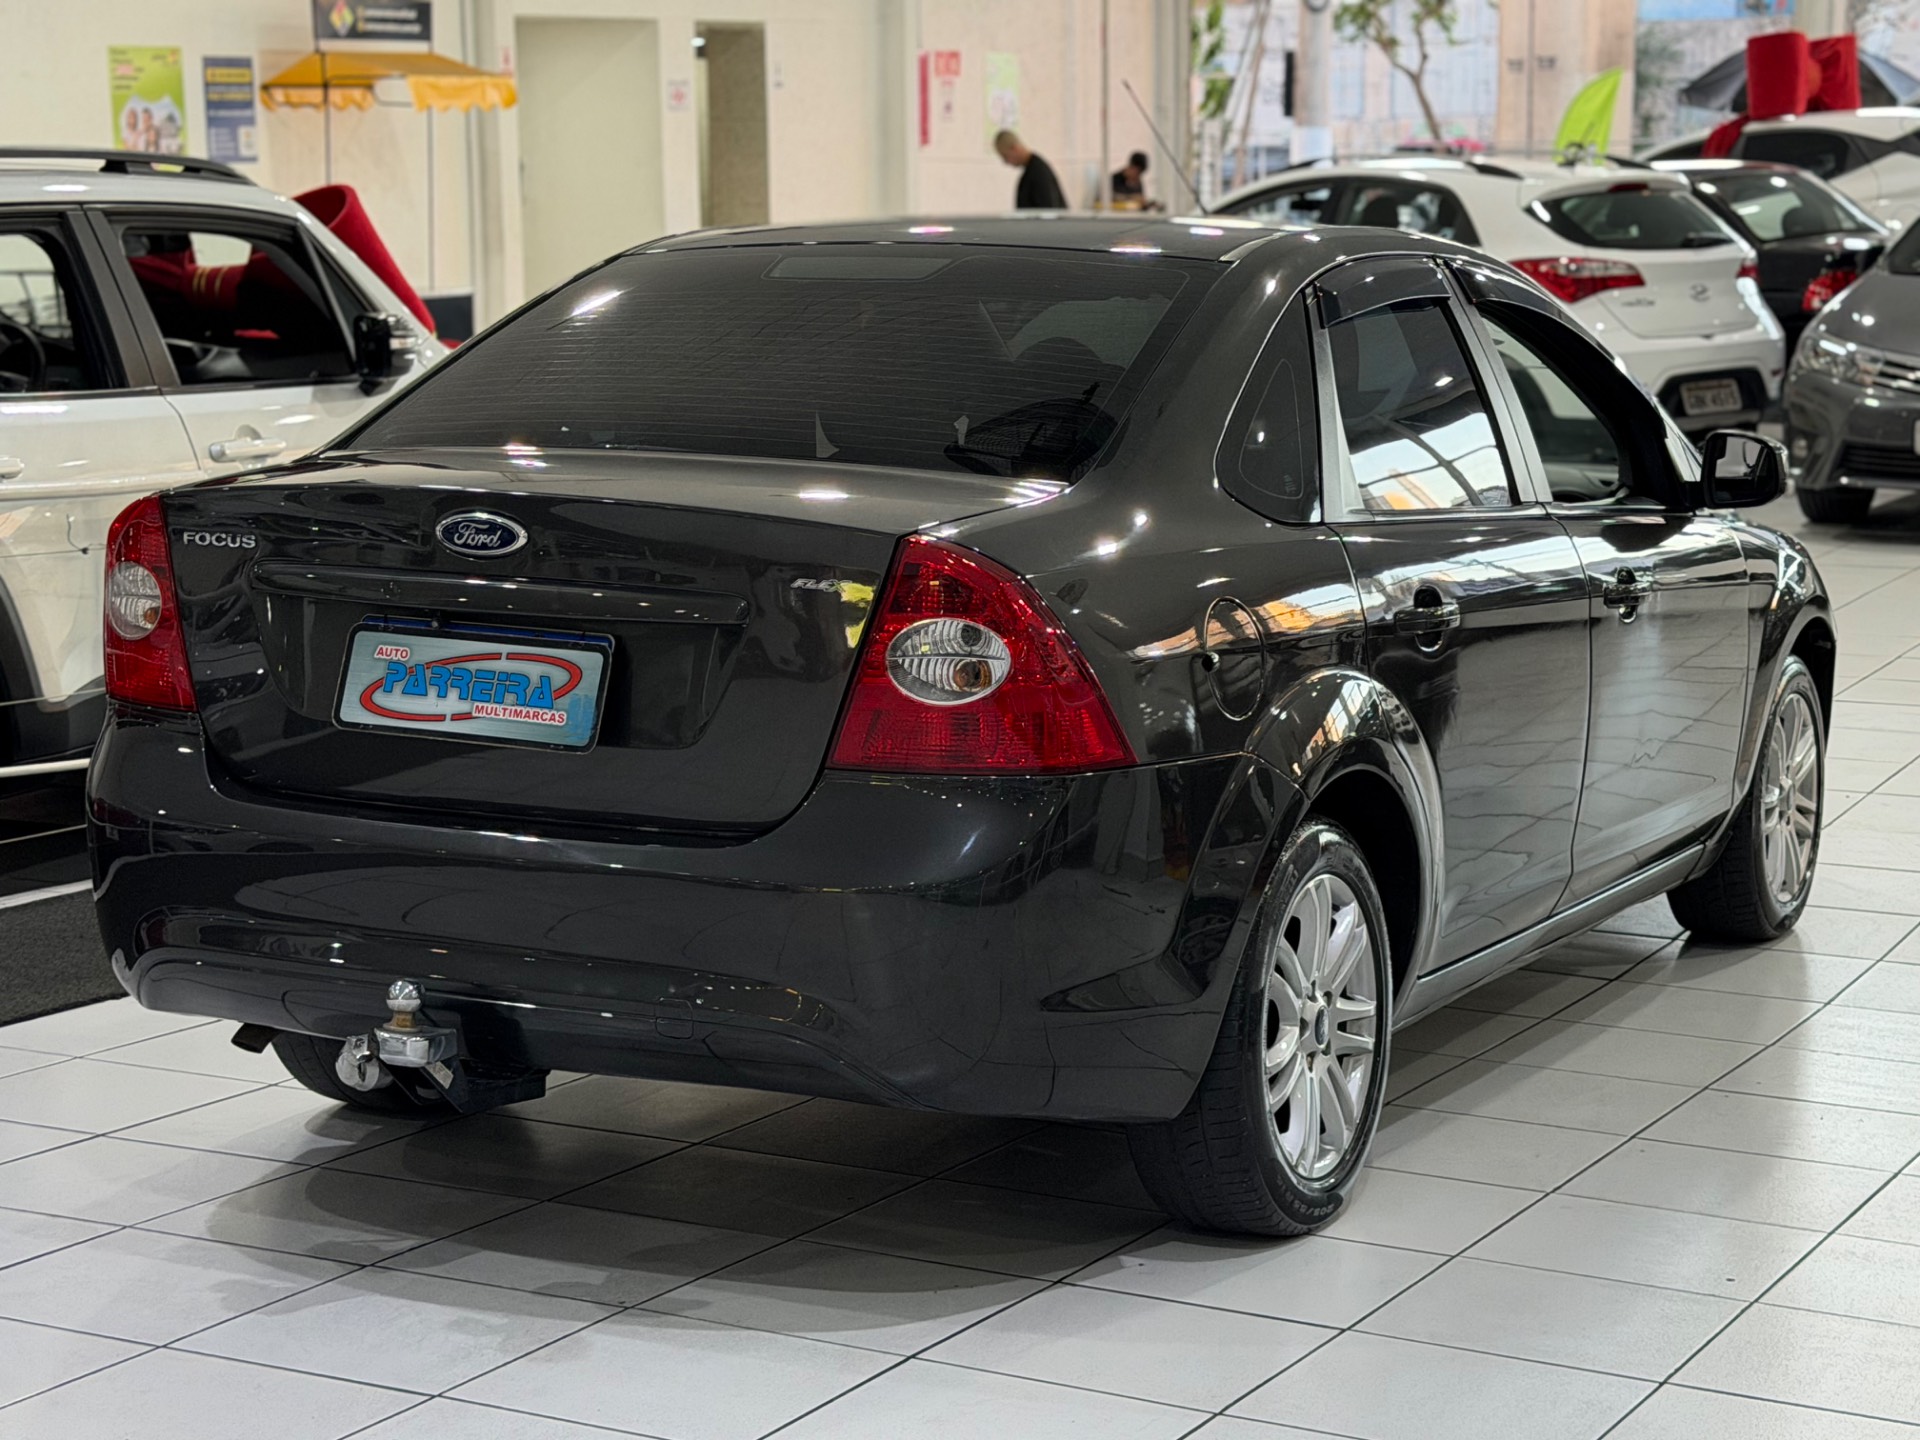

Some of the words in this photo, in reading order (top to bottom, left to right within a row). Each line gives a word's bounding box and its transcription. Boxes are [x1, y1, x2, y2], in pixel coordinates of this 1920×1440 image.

[183, 531, 257, 549] FOCUS
[453, 521, 503, 548] Ford
[790, 577, 853, 593] FLEX
[376, 646, 410, 660] AUTO
[383, 661, 555, 710] PARREIRA
[474, 704, 566, 725] MULTIMARCAS
